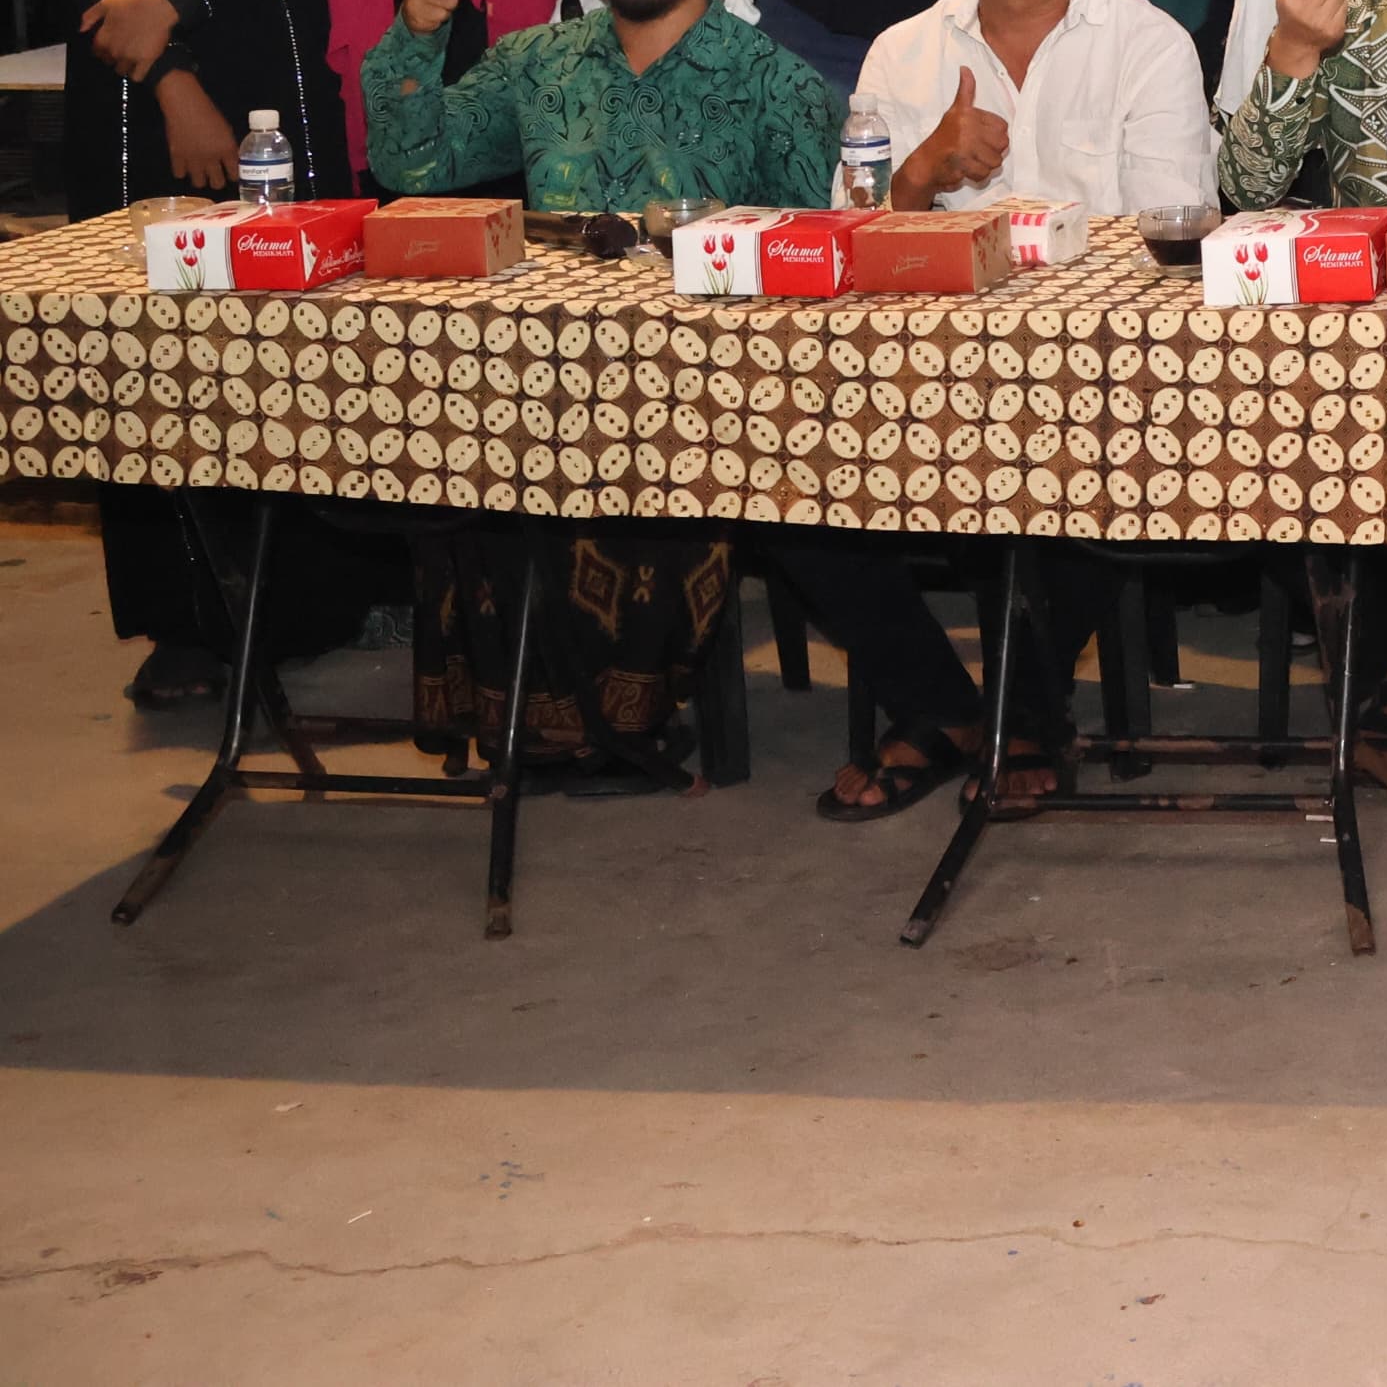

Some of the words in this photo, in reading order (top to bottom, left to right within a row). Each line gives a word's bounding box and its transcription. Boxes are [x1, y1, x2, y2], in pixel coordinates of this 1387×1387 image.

[237, 233, 293, 254] Selamat
[767, 238, 824, 259] Selamat
[1303, 244, 1363, 266] Selamat
